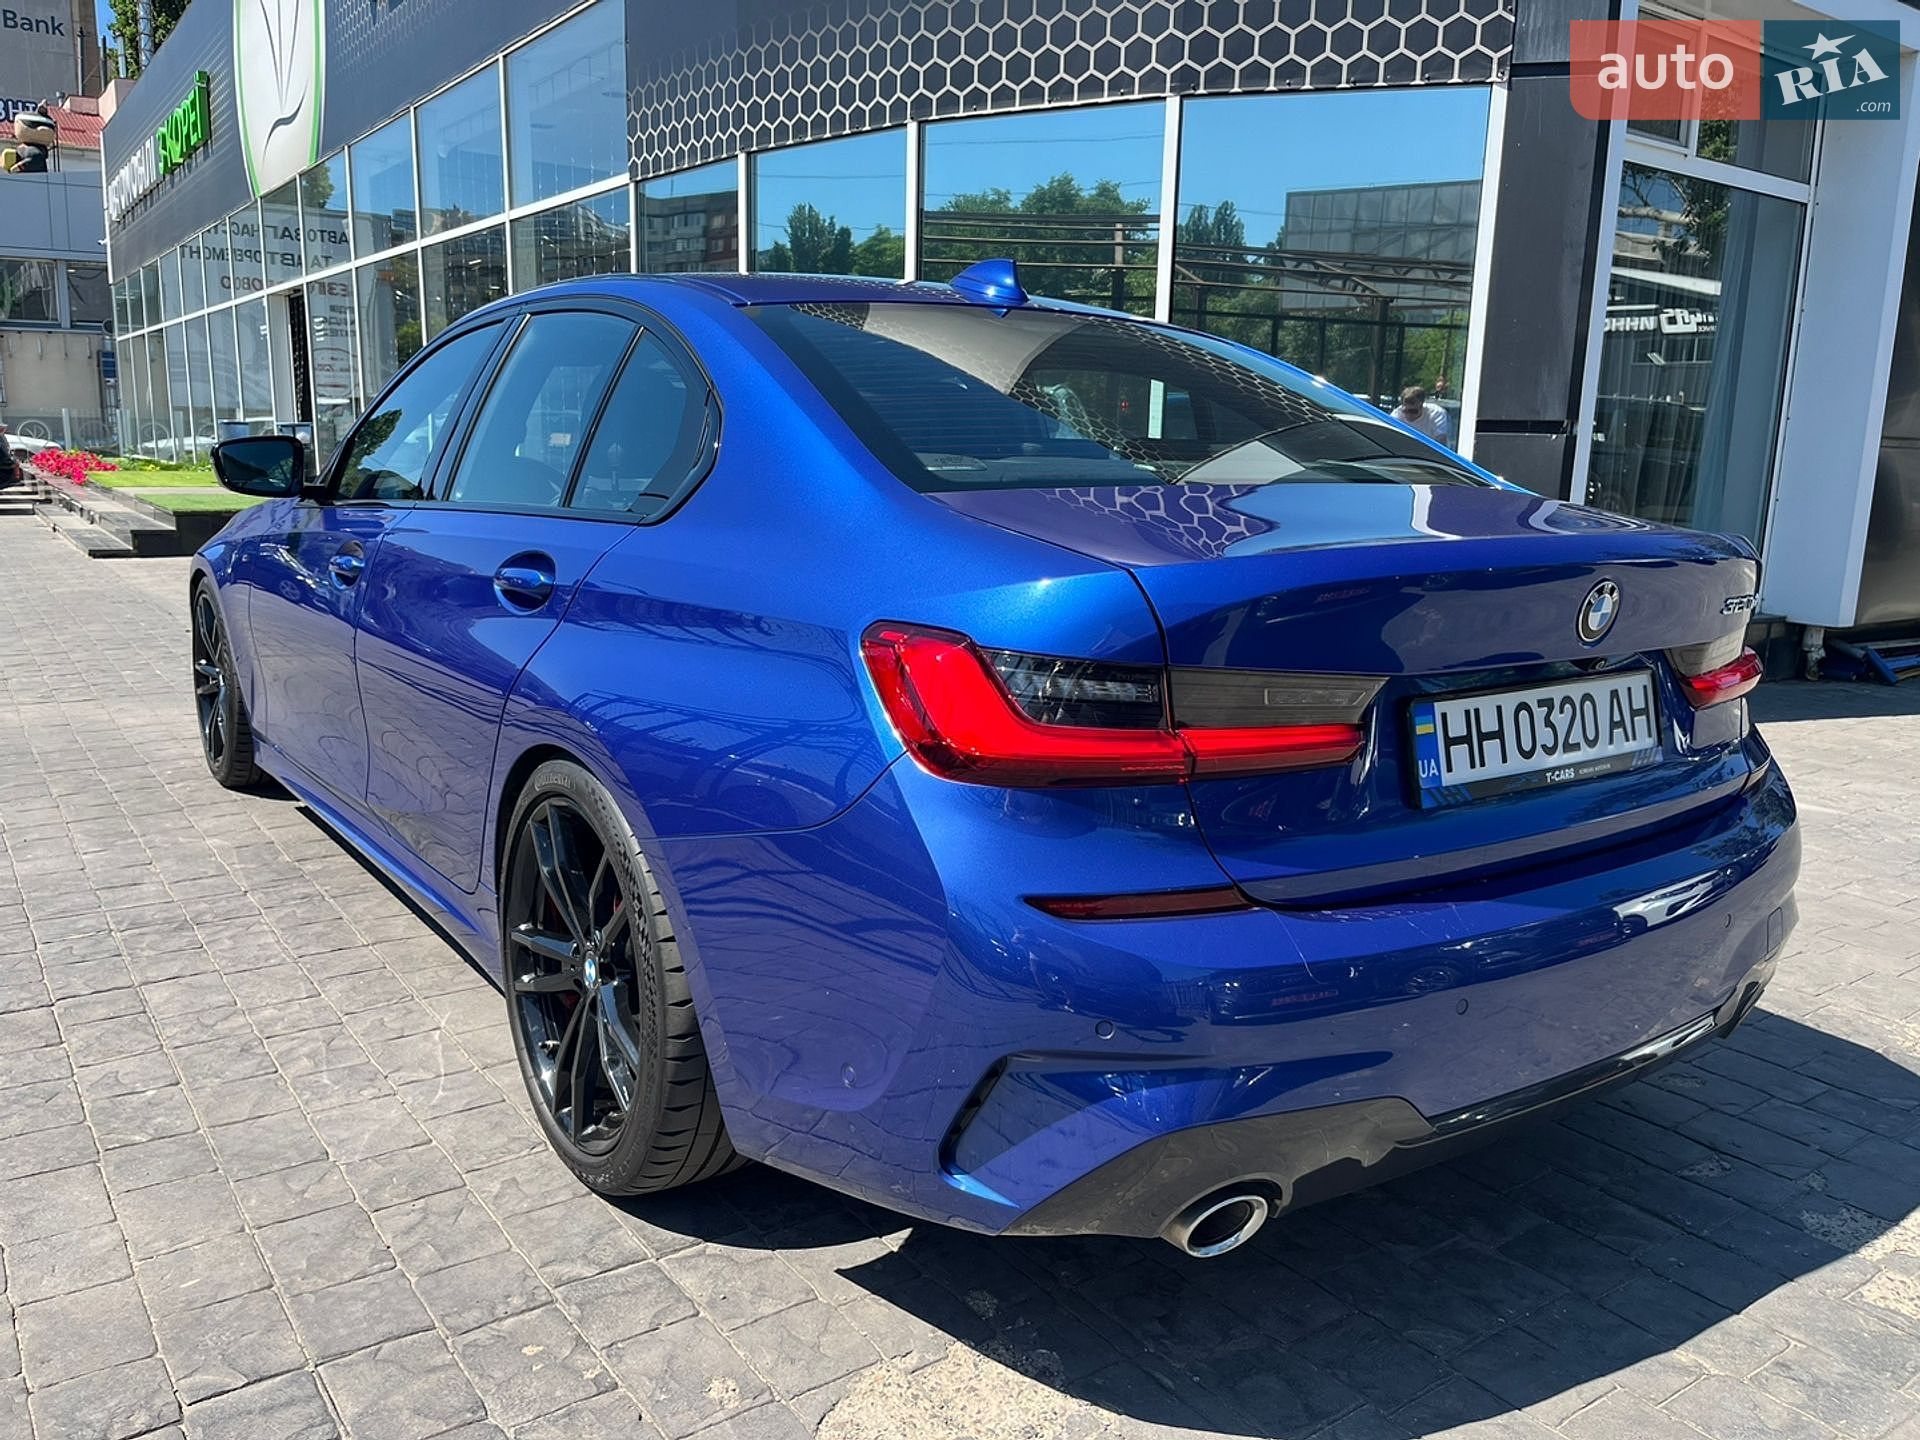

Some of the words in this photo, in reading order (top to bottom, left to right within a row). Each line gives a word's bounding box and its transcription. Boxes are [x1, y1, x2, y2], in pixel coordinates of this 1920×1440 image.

[2, 9, 65, 37] Bank
[1419, 758, 1439, 778] UA
[1545, 768, 1575, 783] T-CARS
